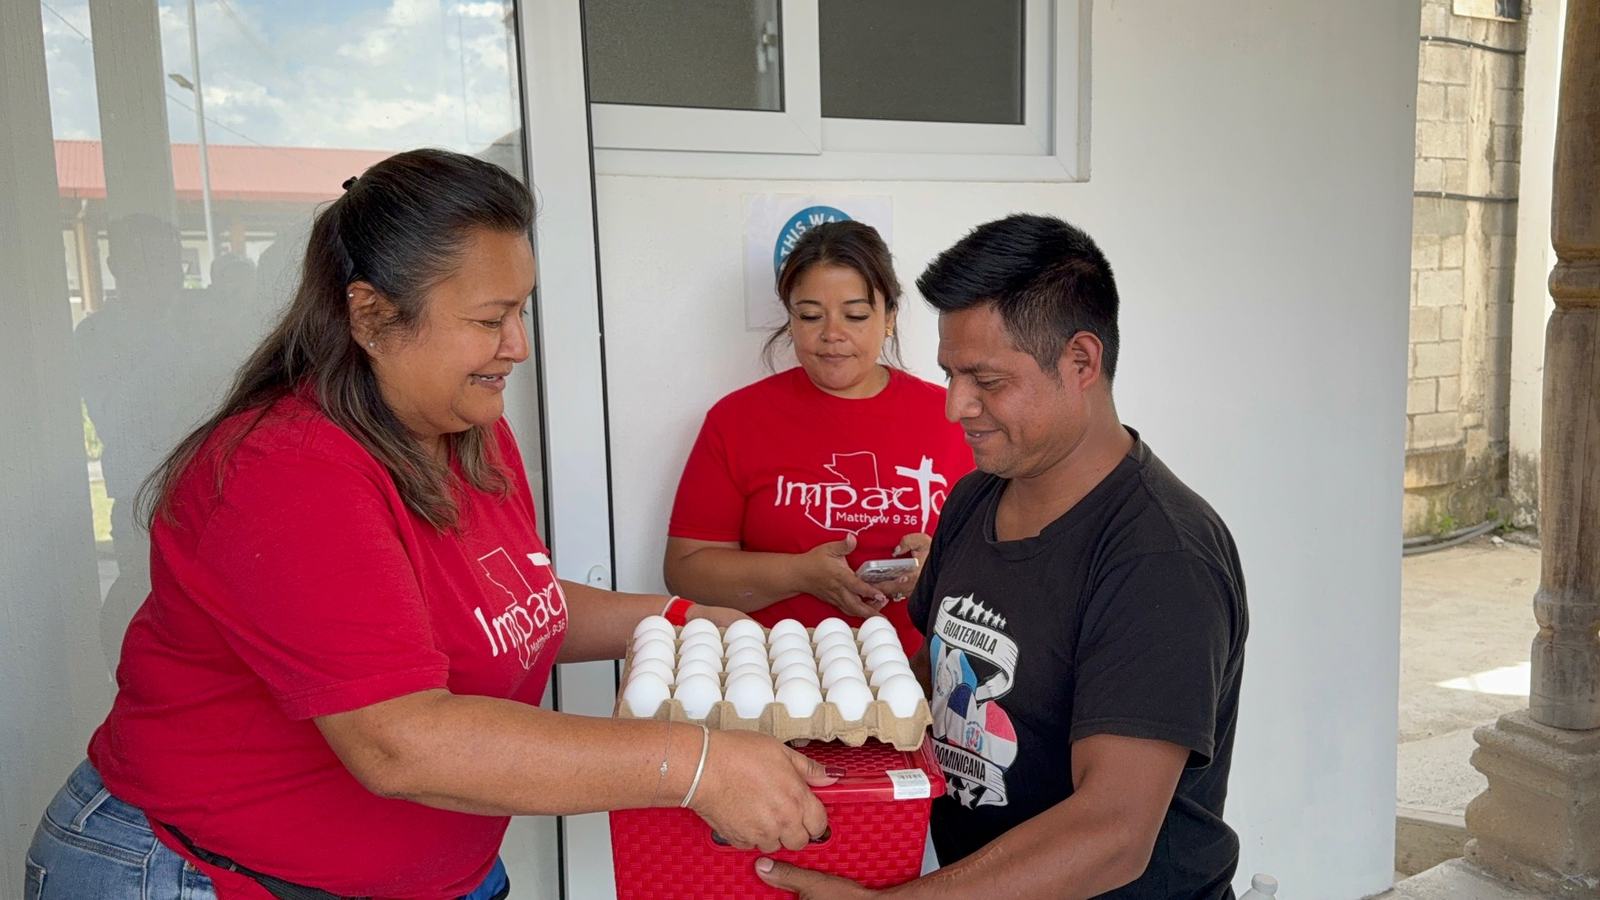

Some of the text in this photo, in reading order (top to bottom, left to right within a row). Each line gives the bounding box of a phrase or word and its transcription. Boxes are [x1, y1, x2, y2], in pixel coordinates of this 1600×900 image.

[780, 221, 806, 257] THIS
[836, 511, 889, 524] Matthew
[943, 619, 998, 655] GUATEMALA
